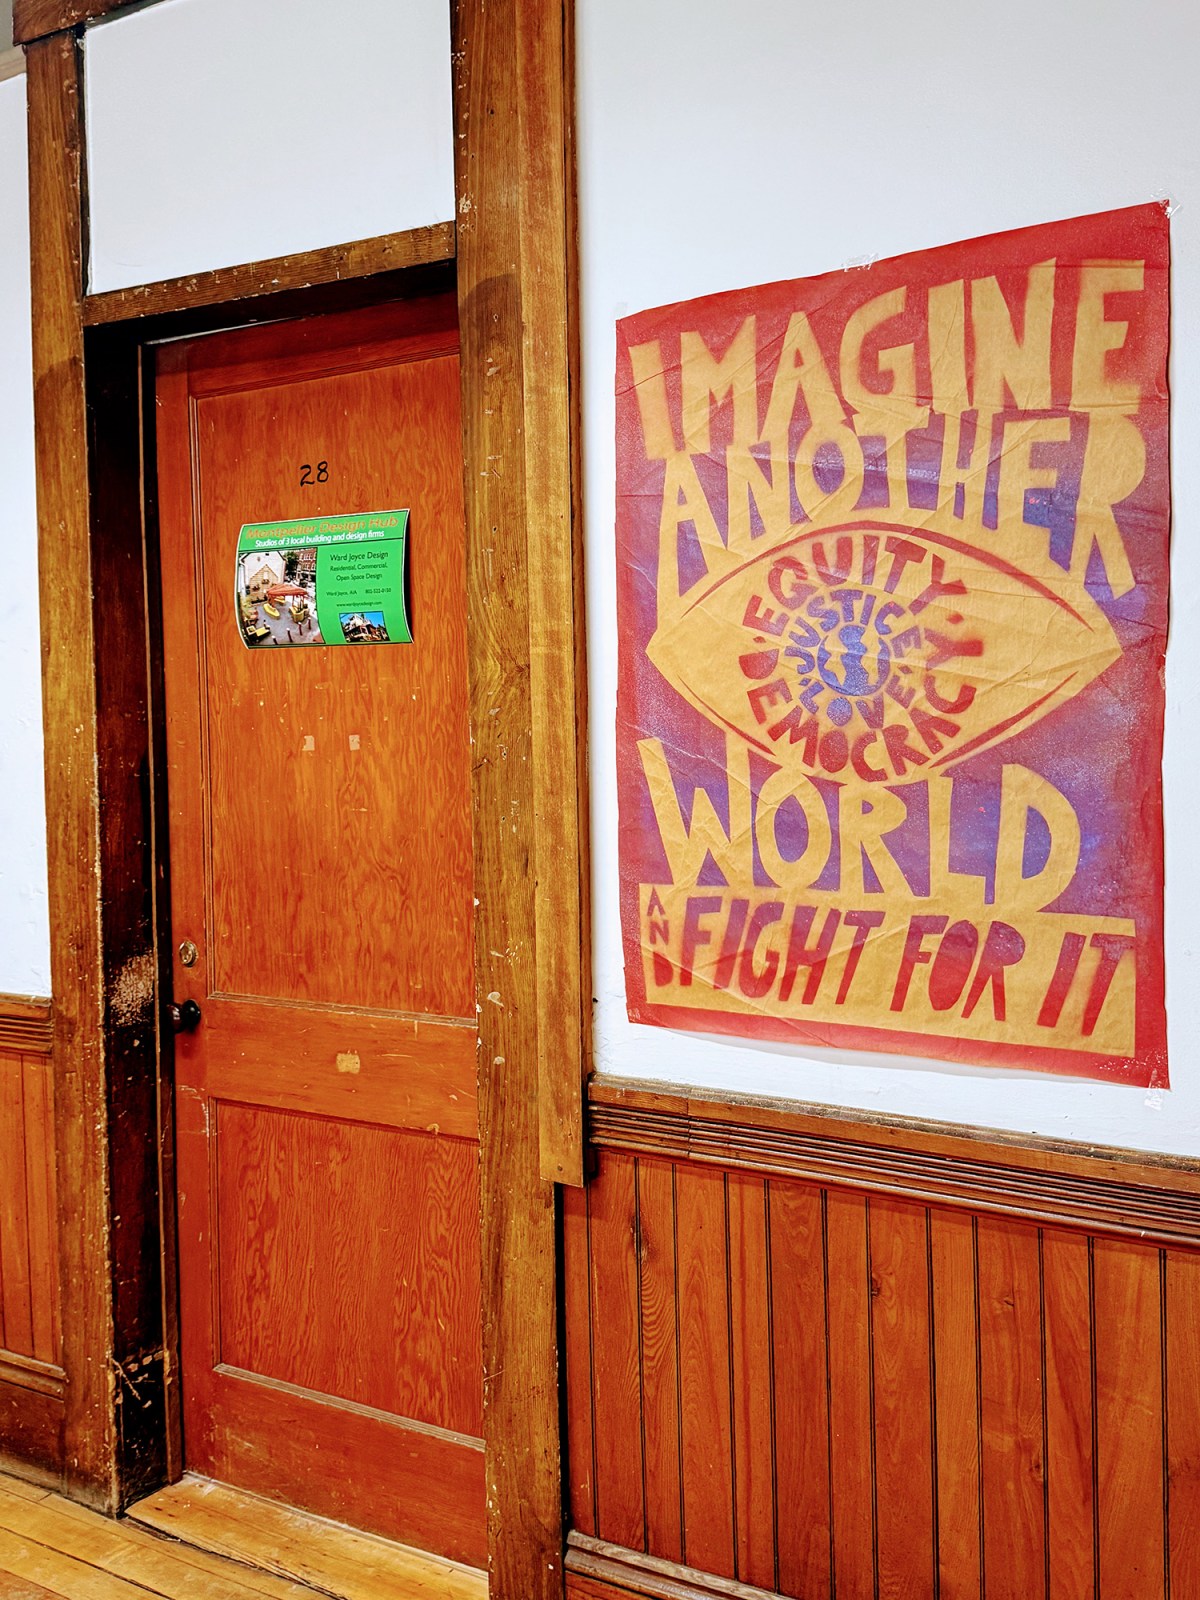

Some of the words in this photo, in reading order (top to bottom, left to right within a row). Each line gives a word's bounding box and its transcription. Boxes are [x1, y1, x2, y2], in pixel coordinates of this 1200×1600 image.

[628, 257, 1145, 461] IMAGINE
[300, 460, 329, 487] 28
[656, 410, 1148, 618] ANOTHER
[246, 525, 316, 539] Montpelier
[320, 521, 366, 532] Design
[368, 516, 398, 528] Hub
[255, 539, 278, 548] Studios
[286, 537, 291, 545] 3
[291, 536, 306, 545] local
[306, 533, 332, 543] building
[332, 533, 345, 541] and
[345, 531, 367, 541] design
[330, 553, 348, 561] Ward
[348, 554, 366, 562] Joyce
[366, 551, 389, 560] Design
[739, 628, 984, 782] DEMOCRACY
[799, 675, 916, 727] LOVE
[637, 737, 1081, 913] WORLD
[679, 896, 886, 1005] FIGHT
[890, 913, 1026, 1022] FOR
[1036, 932, 1136, 1036] IT
